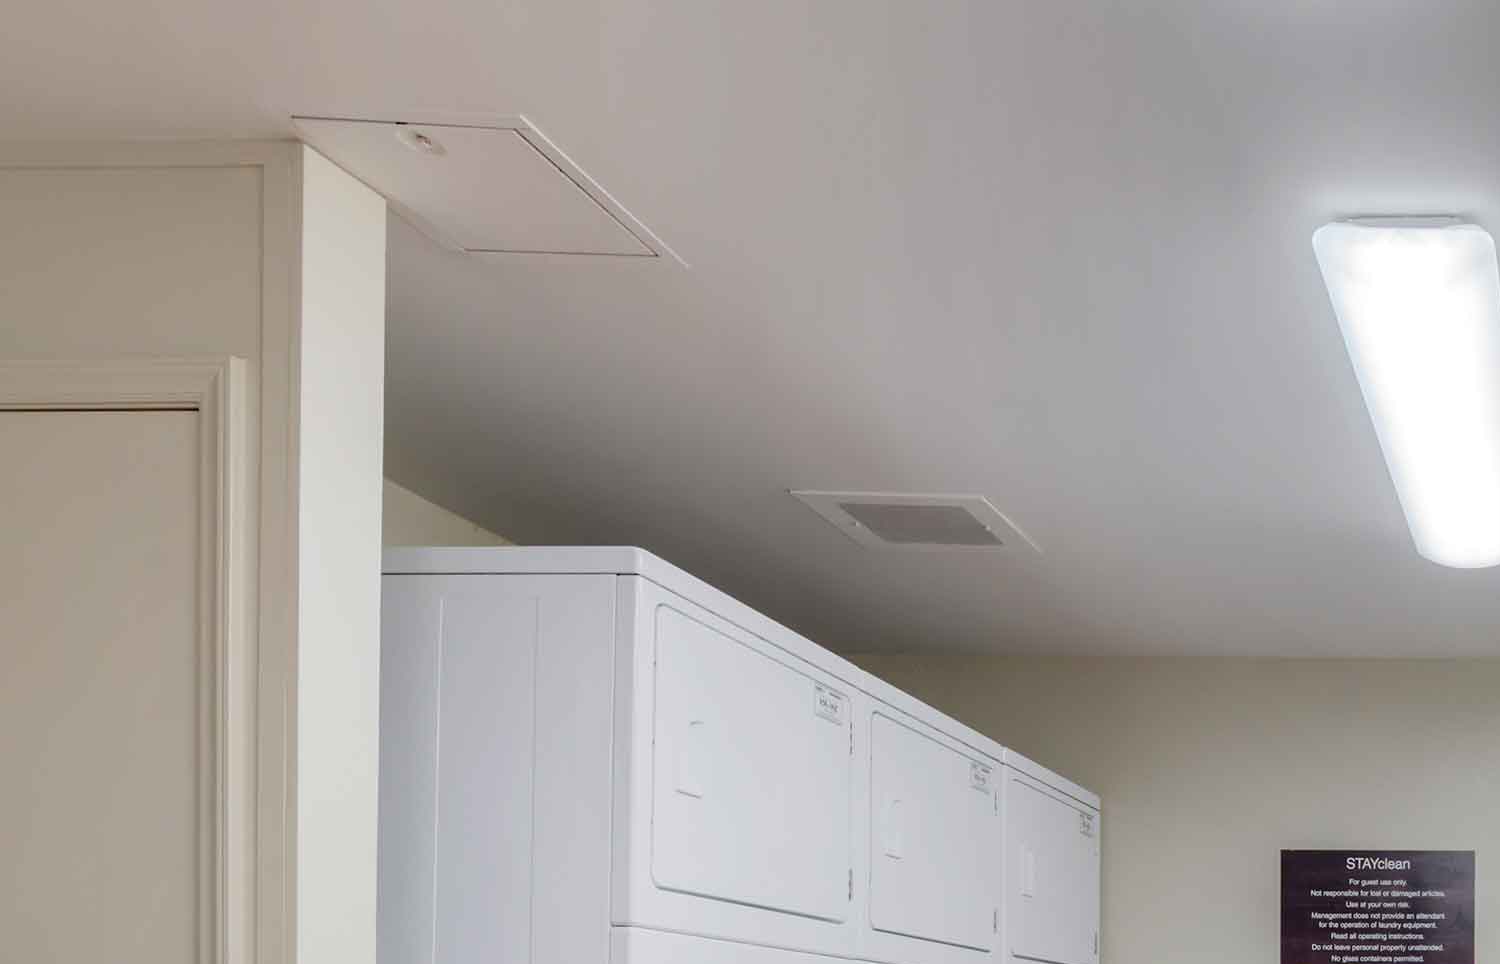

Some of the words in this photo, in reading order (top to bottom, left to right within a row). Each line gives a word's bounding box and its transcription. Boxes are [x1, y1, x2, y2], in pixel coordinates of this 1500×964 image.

[1346, 857, 1411, 870] STAYclean
[1361, 879, 1378, 887] guest
[1323, 890, 1359, 898] responsible
[1390, 890, 1420, 898] damaged
[1358, 933, 1387, 941] operating
[1352, 944, 1379, 952] personal
[1342, 955, 1359, 963] glass
